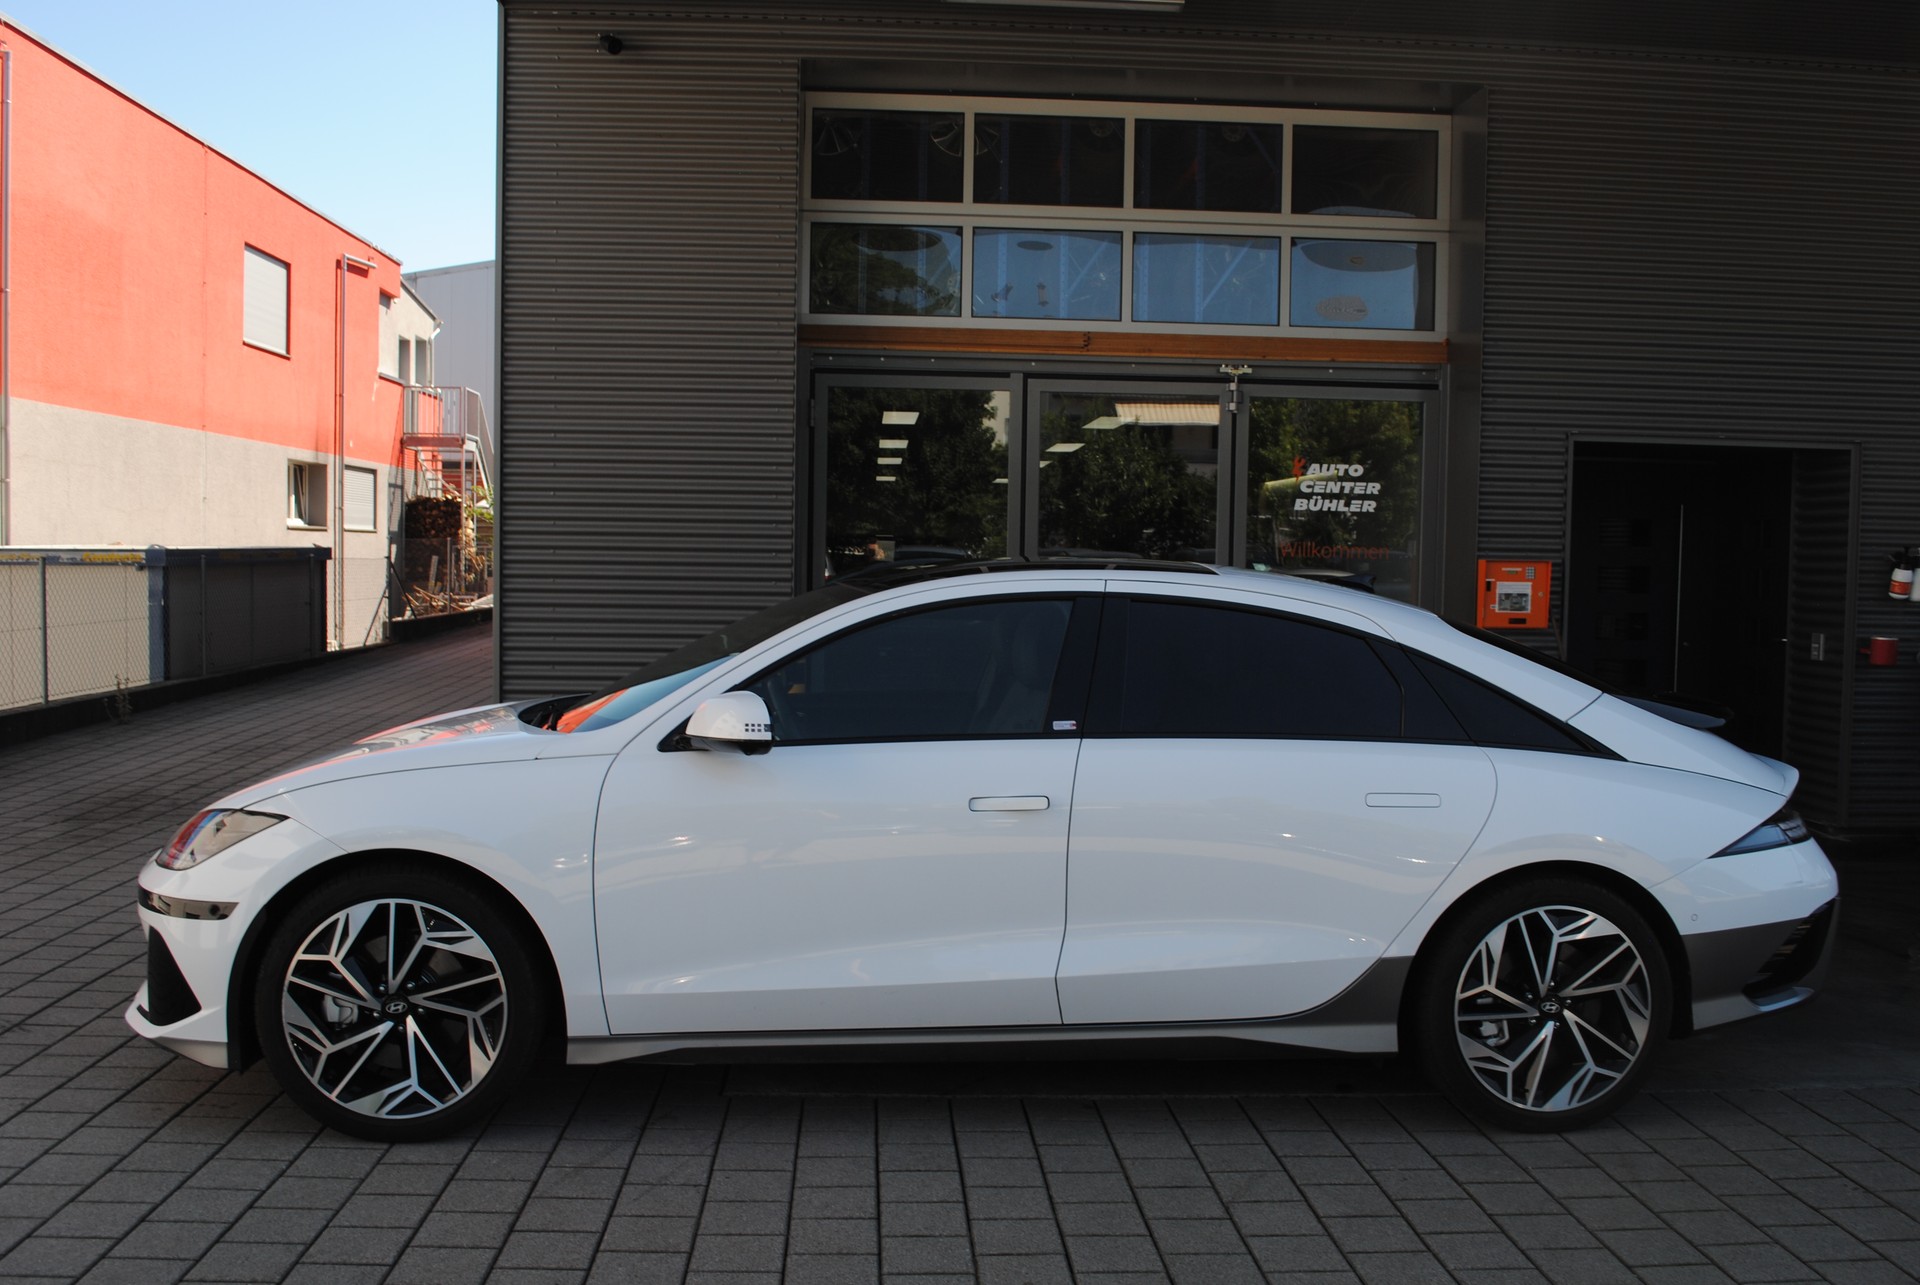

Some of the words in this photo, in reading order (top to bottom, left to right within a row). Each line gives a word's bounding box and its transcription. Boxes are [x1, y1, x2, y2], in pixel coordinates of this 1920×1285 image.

[1306, 463, 1364, 477] AUTO
[1300, 481, 1381, 495] CENTER
[1294, 495, 1377, 512] BÜHLER
[1280, 540, 1389, 560] Willkommen
